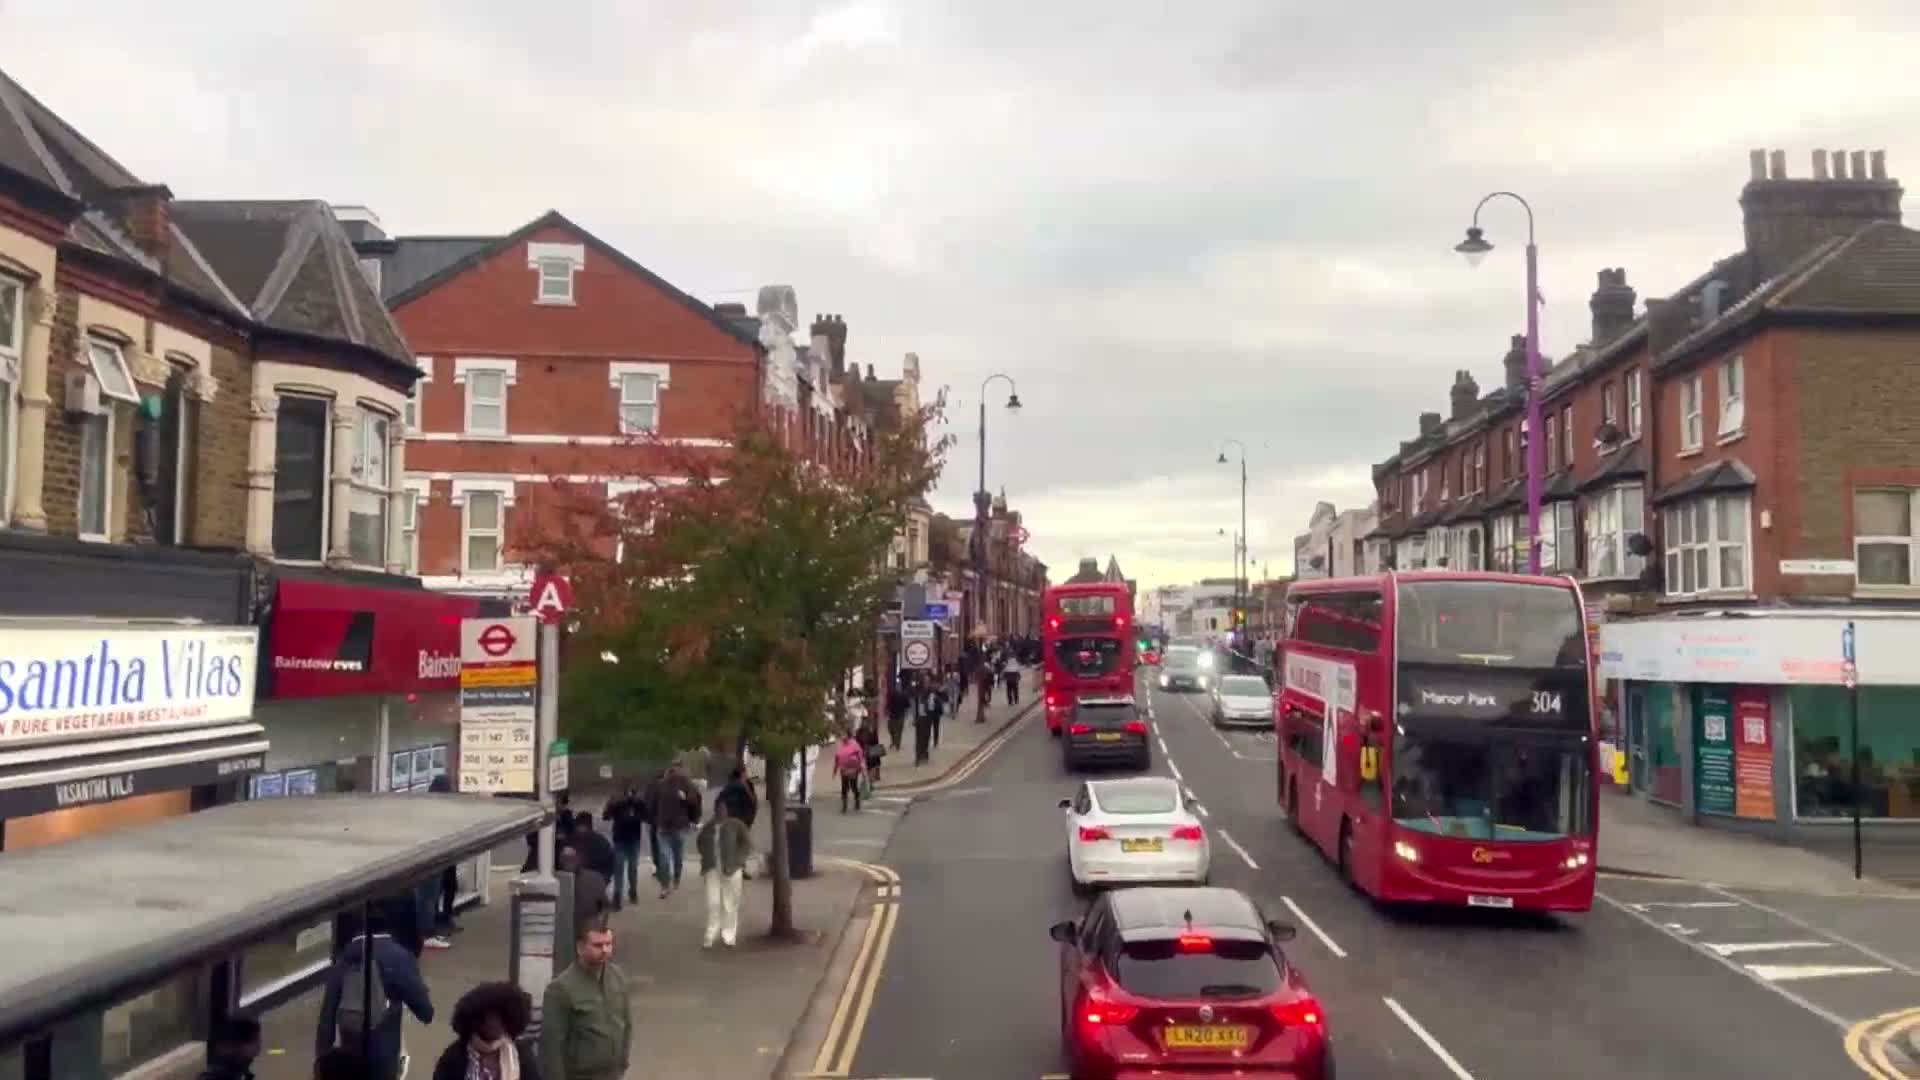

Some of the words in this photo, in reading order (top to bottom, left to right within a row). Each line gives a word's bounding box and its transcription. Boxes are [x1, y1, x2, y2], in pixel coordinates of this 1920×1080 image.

[537, 582, 564, 611] A
[162, 640, 241, 698] Vilas
[275, 656, 332, 671] Bairstow
[334, 660, 362, 671] eves
[1422, 690, 1464, 704] Manor
[1468, 690, 1497, 706] Park
[1531, 690, 1561, 712] 304
[11, 718, 49, 735] PURE
[56, 708, 134, 732] VEGETARIAN
[56, 781, 107, 806] VASANTHA
